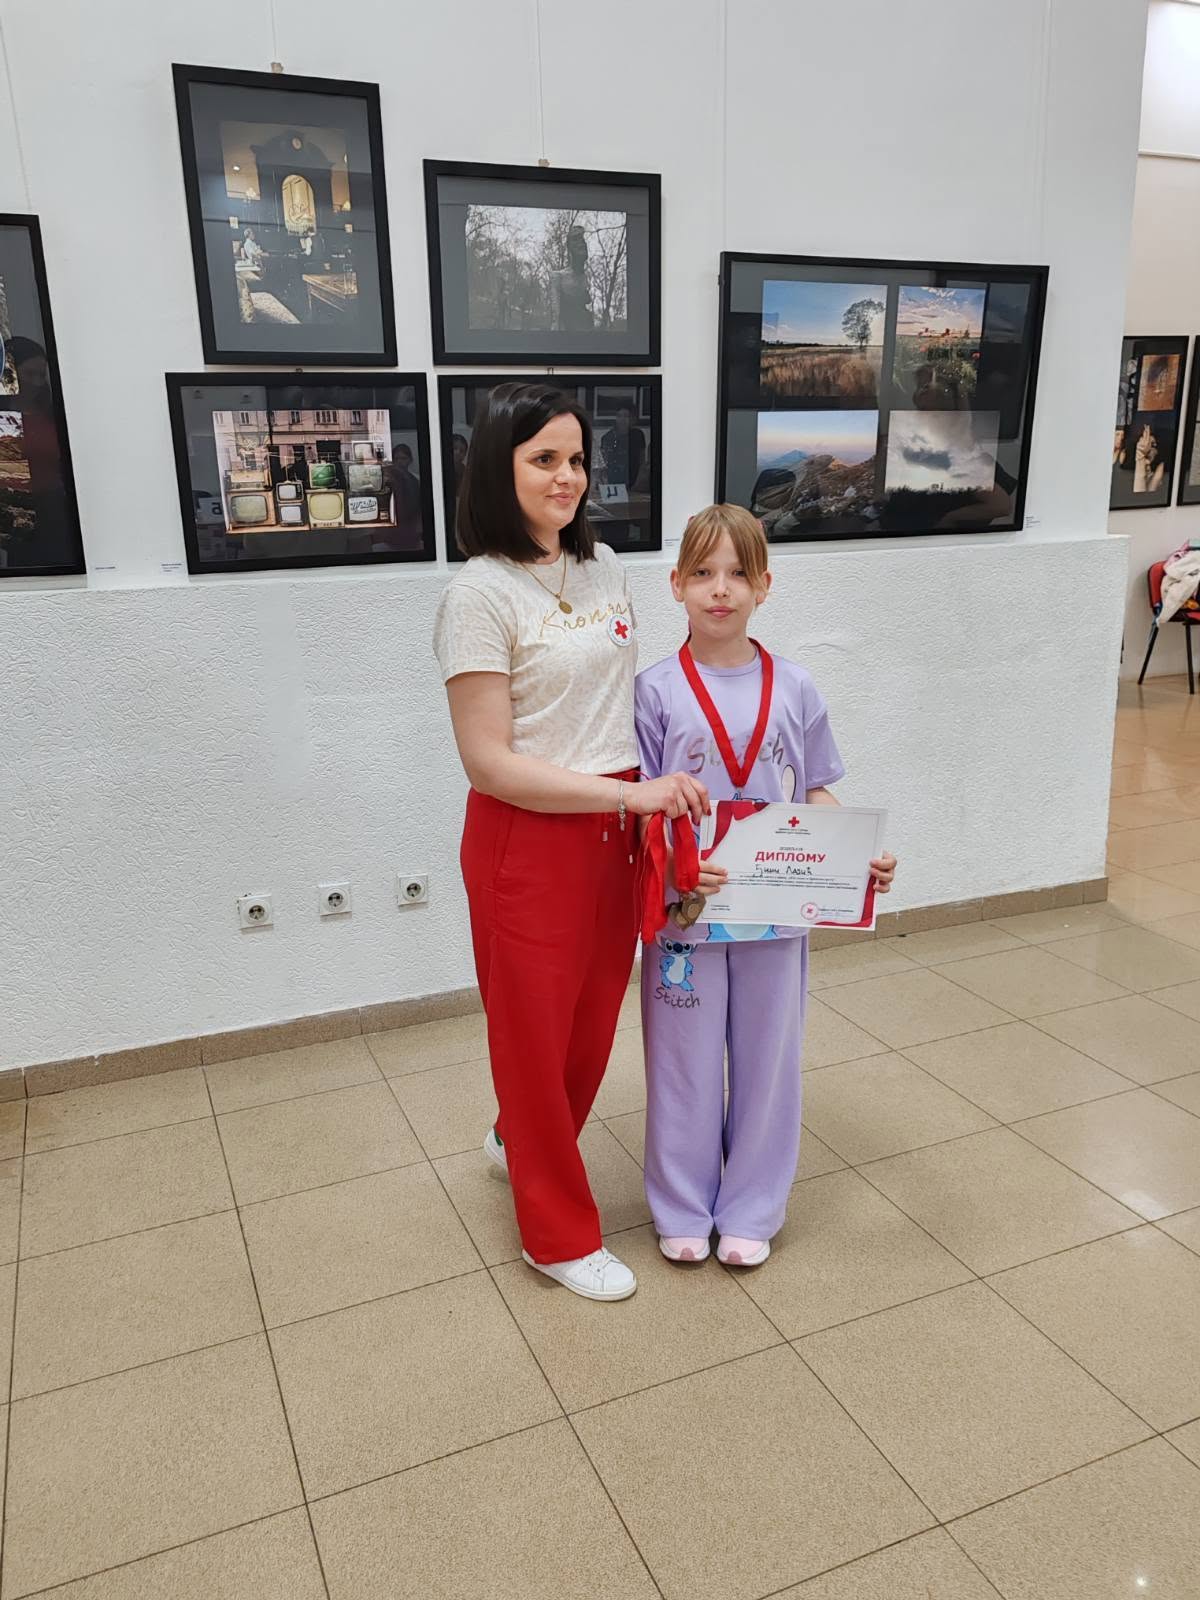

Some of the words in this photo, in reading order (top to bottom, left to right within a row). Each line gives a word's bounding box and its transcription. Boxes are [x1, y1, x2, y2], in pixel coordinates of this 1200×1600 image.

[687, 732, 784, 775] Stch
[755, 851, 826, 863] ДИПЛОМУ
[654, 987, 700, 1009] Stitch
